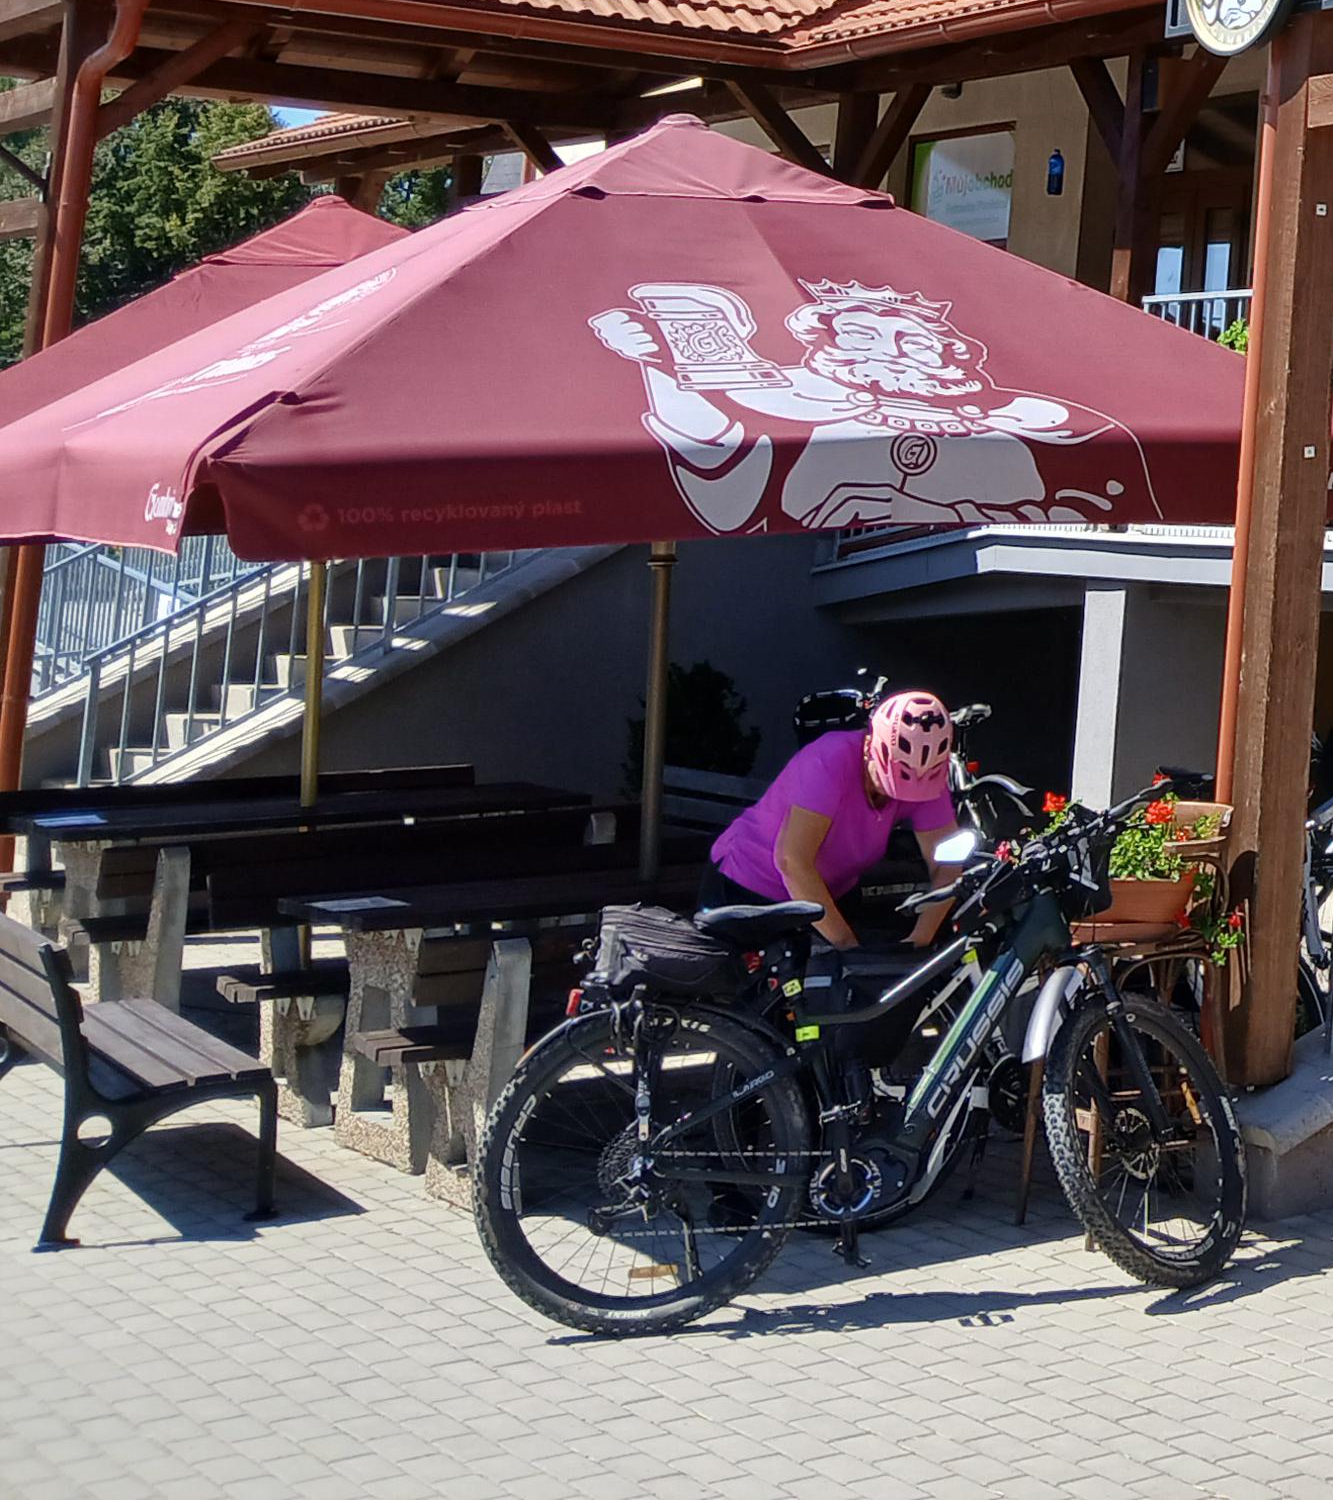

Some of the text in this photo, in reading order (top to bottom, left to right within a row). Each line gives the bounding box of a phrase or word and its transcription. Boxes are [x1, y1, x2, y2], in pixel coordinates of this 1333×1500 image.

[337, 499, 583, 525] 100% recyklovaný plast
[927, 957, 1025, 1119] CRUSSIS
